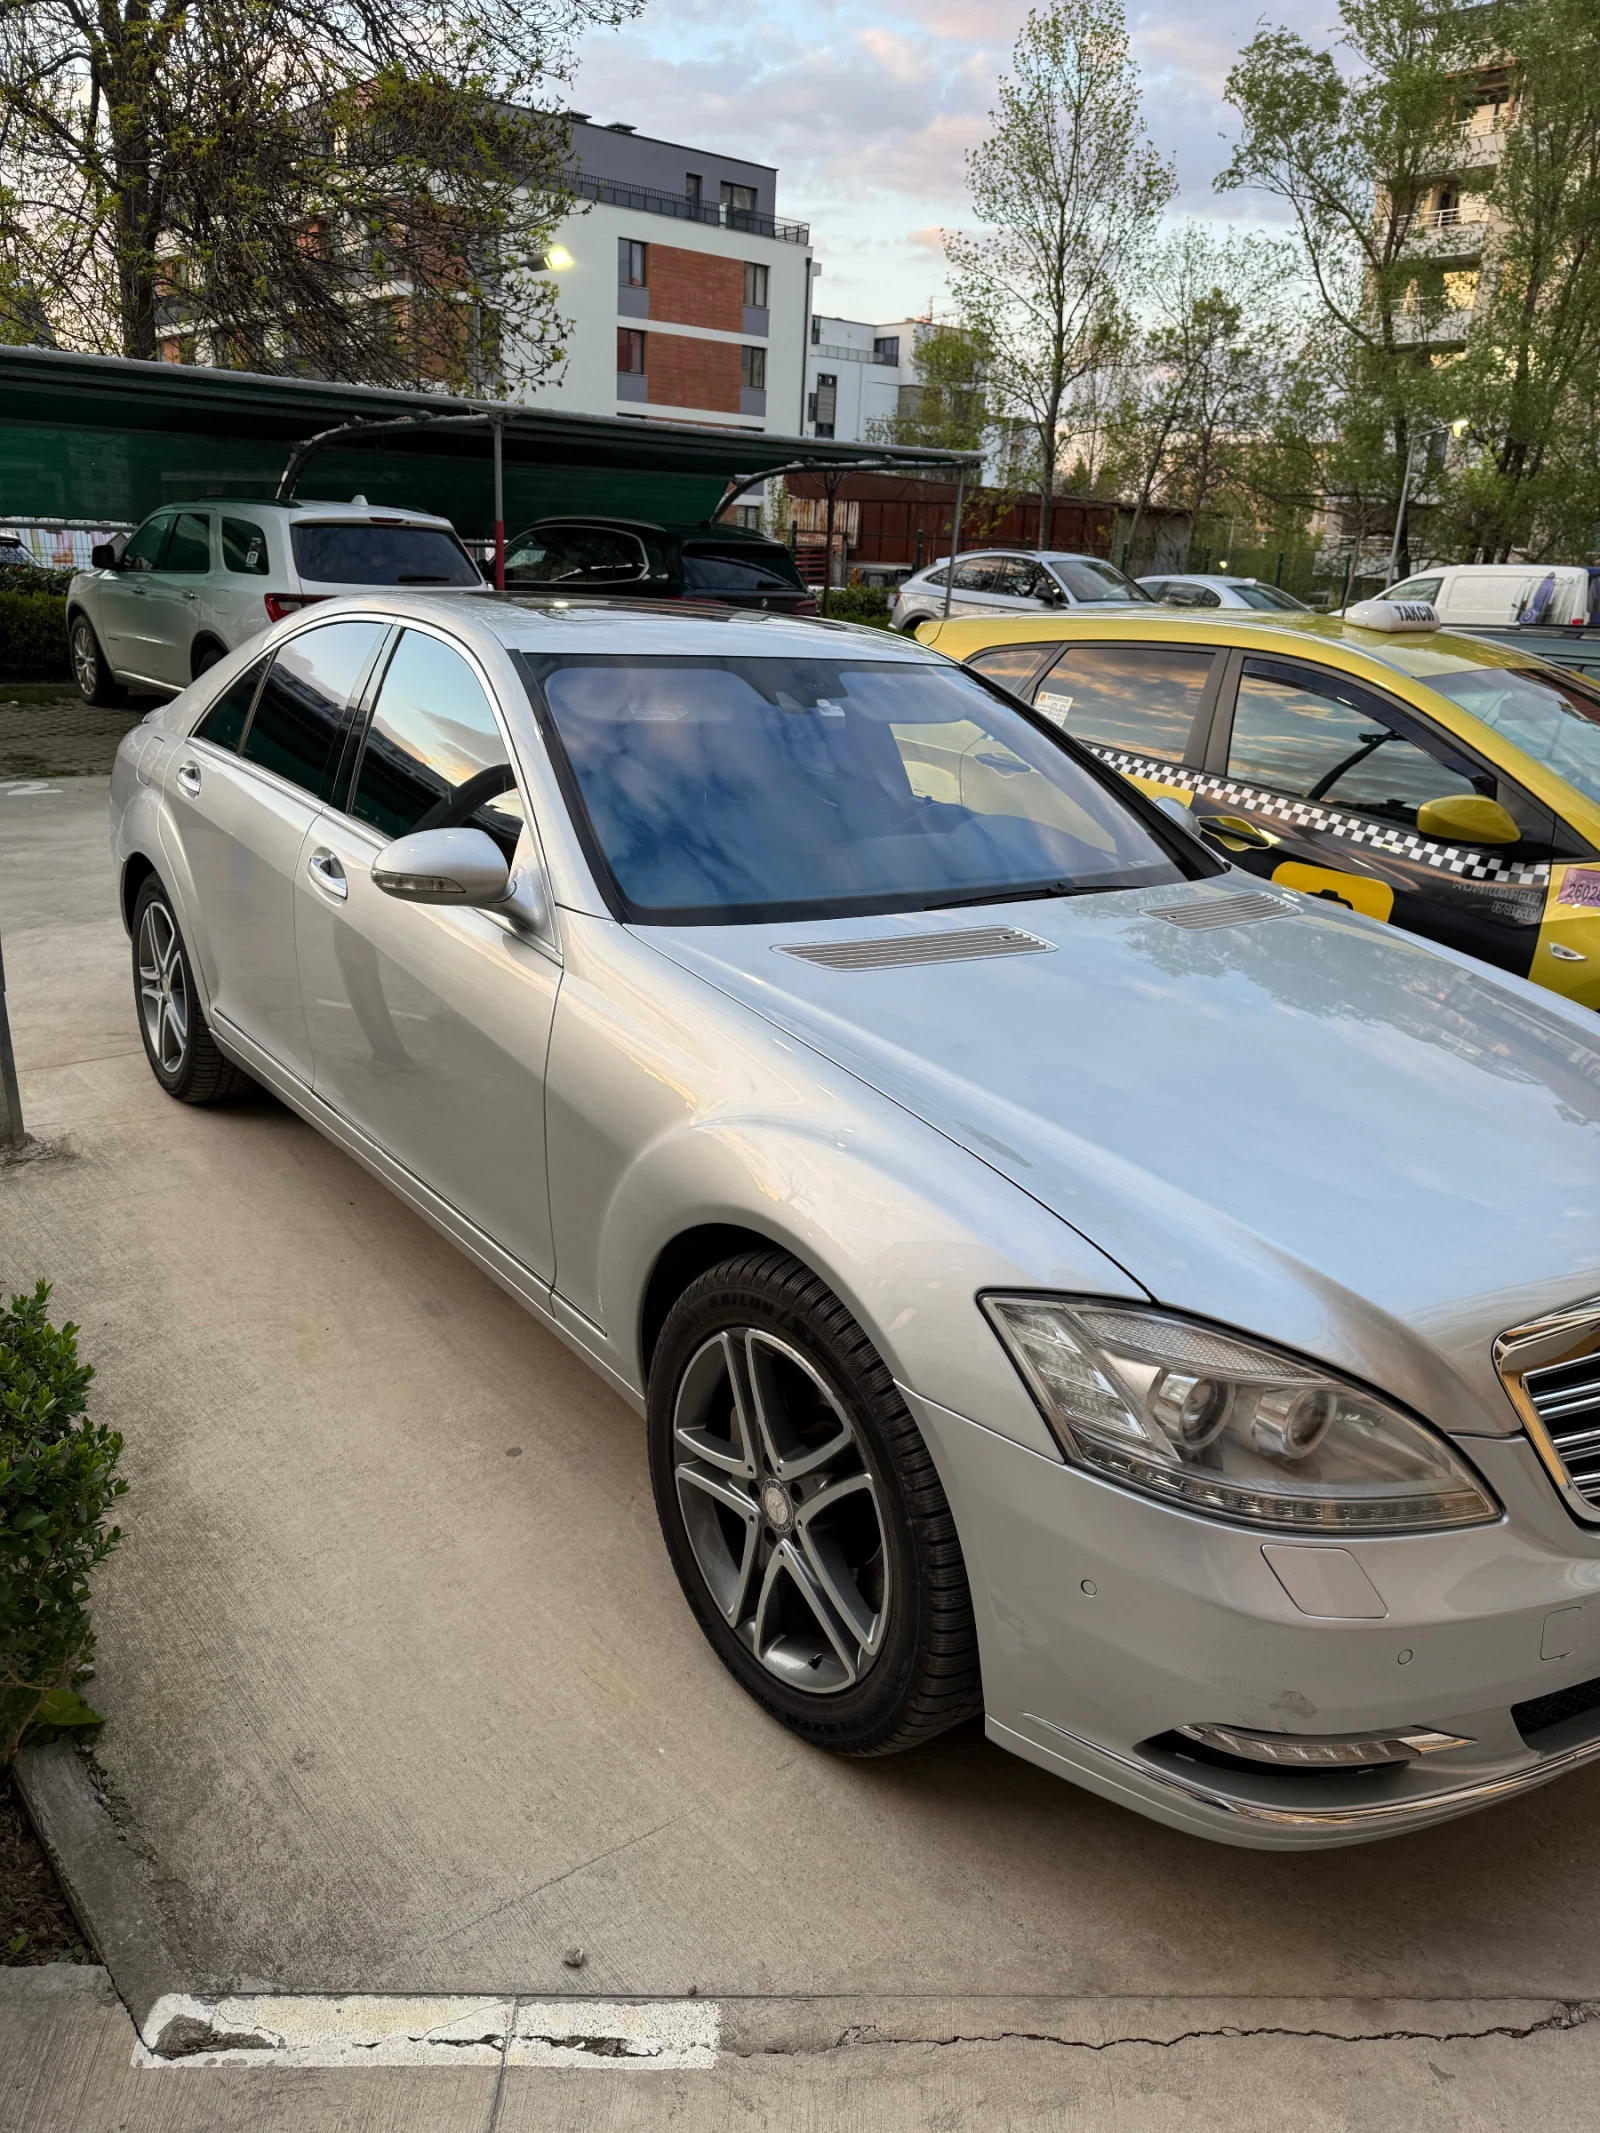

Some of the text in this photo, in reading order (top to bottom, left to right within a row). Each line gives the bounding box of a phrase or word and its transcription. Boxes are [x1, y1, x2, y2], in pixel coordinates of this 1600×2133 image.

[1394, 605, 1434, 621] ТАКСИ
[708, 1293, 774, 1317] SAILUN
[785, 1711, 861, 1735] BLAZER
